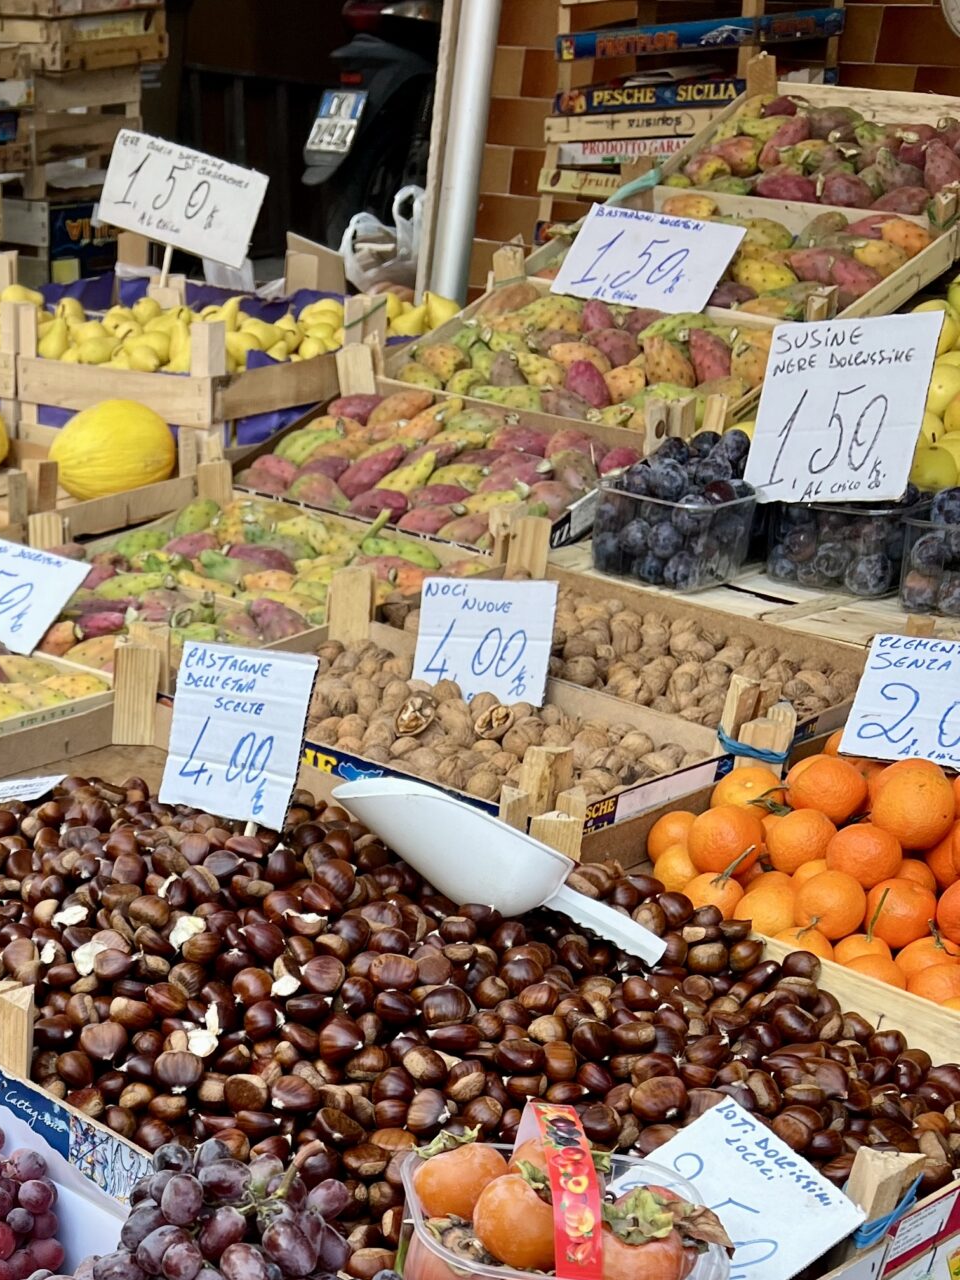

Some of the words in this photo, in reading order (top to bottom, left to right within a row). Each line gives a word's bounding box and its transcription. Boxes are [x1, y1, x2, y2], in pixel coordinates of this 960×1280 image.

[592, 87, 656, 107] PESCHE
[675, 79, 738, 103] SICILIA
[581, 140, 647, 155] PRODOTTO
[772, 358, 818, 377] NERE
[461, 597, 513, 614] NUOVE
[423, 617, 528, 684] 4,00
[183, 646, 273, 678] CASTAGNE
[870, 651, 953, 672] SENZA
[213, 696, 266, 716] SCELTE
[178, 715, 275, 786] 4,00
